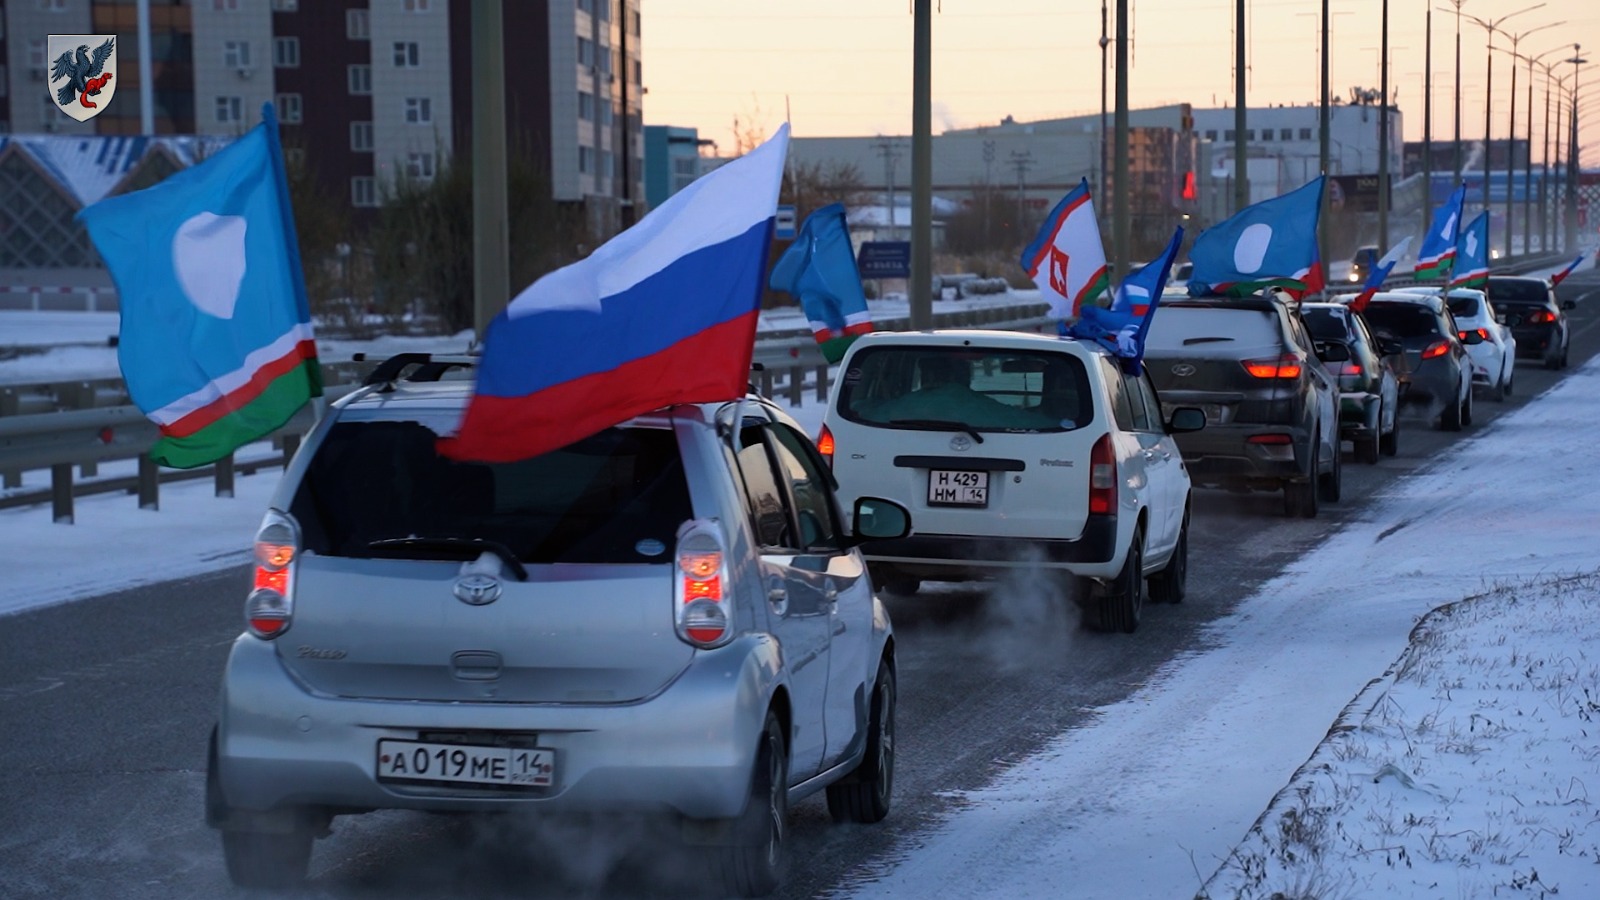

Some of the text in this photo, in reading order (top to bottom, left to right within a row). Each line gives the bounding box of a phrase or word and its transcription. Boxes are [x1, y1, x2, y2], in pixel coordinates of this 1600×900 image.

[953, 473, 979, 487] 429
[935, 488, 982, 501] НМ 14
[516, 752, 544, 775] 14
